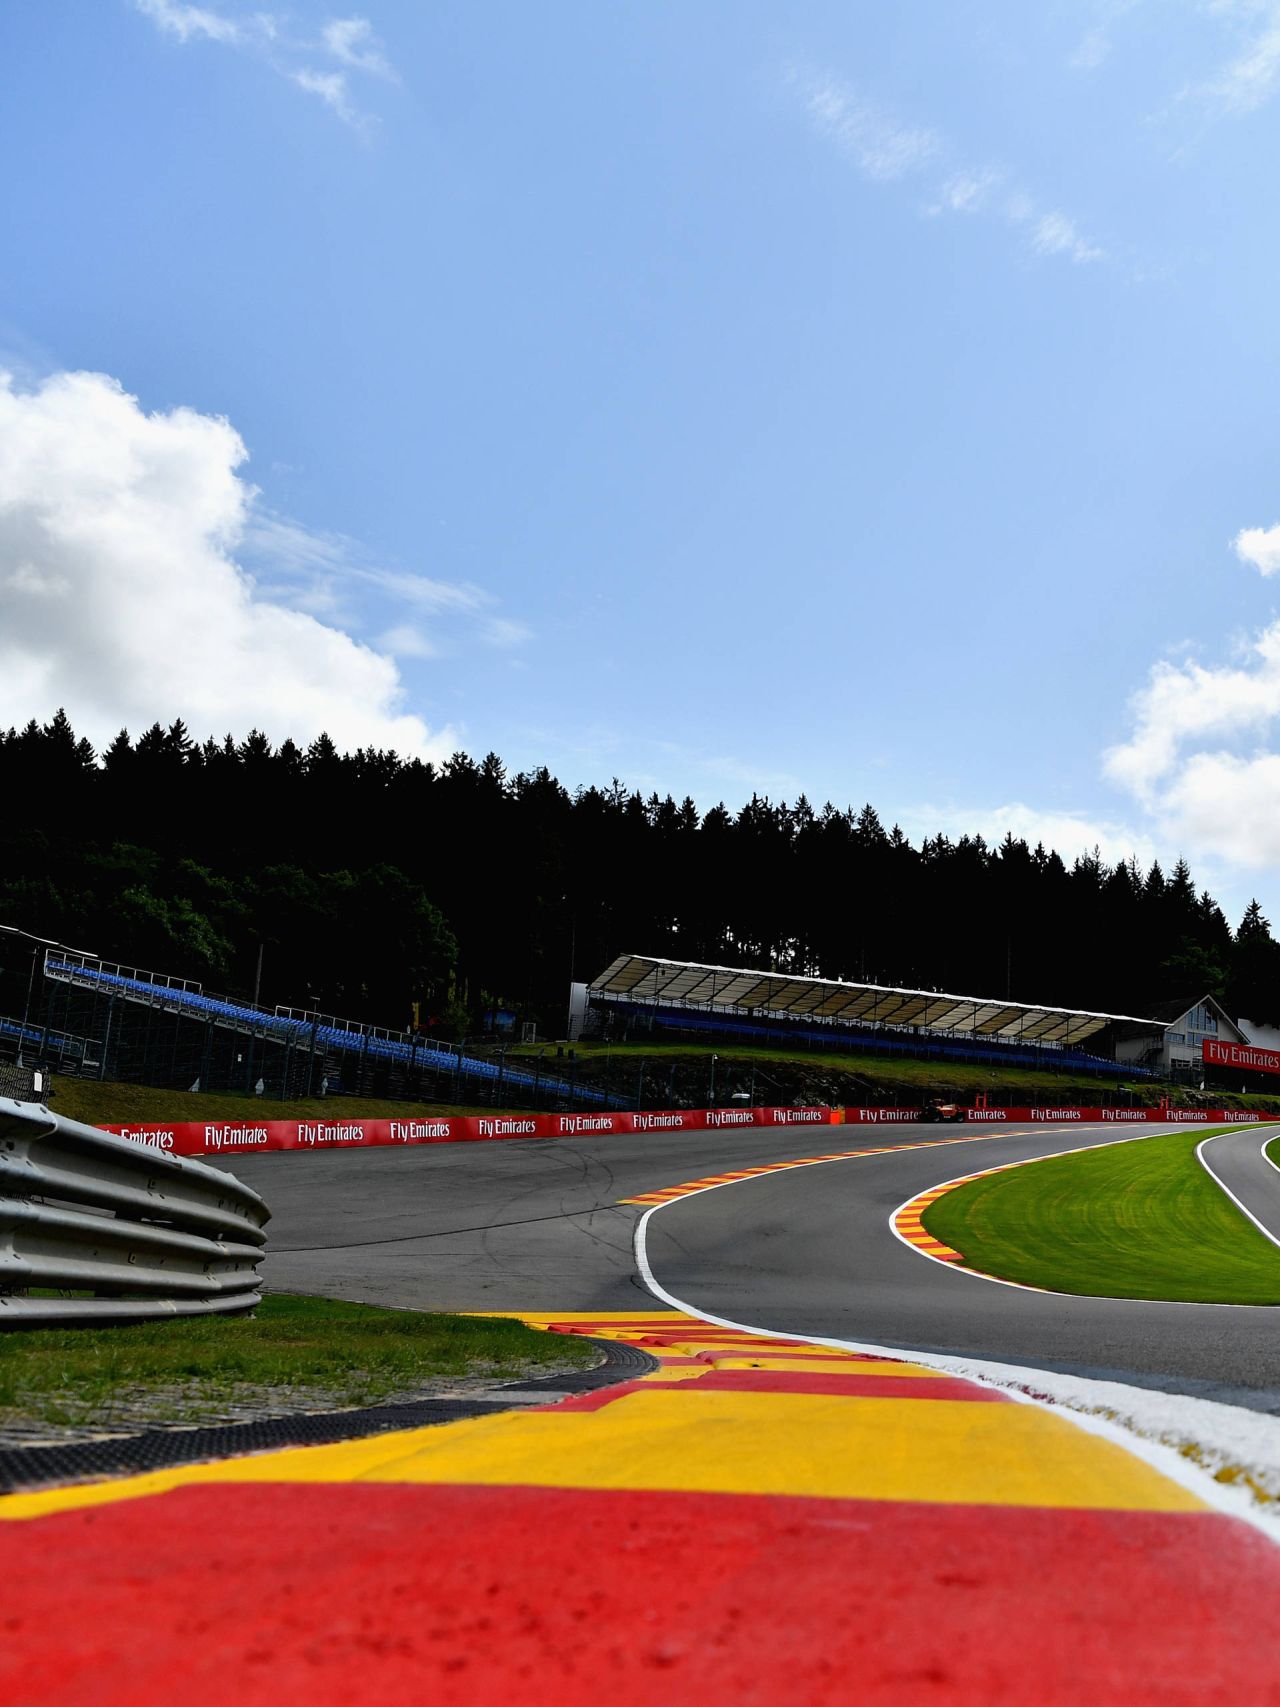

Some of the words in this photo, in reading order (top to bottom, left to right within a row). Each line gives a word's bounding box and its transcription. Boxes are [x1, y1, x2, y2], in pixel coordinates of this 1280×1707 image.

[1210, 1043, 1228, 1063] Fly
[1232, 1046, 1279, 1068] Emirates
[633, 1114, 648, 1130] Fly
[649, 1113, 683, 1127] Emirates
[706, 1112, 721, 1126] Fly
[721, 1110, 754, 1124] Emirates
[773, 1109, 786, 1124] Fly
[787, 1109, 822, 1122] Emirates
[860, 1109, 877, 1122] Fly
[880, 1109, 922, 1120] Emirate
[968, 1109, 1007, 1120] Emirates
[1031, 1109, 1045, 1121] Fly
[1046, 1108, 1081, 1119] Emirates
[1102, 1109, 1114, 1121] Fly
[1116, 1109, 1146, 1119] Emirates
[1166, 1111, 1178, 1121] Fly
[1179, 1110, 1208, 1120] Emirates
[1224, 1111, 1234, 1122] Fly
[1234, 1111, 1260, 1121] Emirates
[390, 1122, 408, 1142] Fly
[410, 1121, 450, 1138] Emirates
[479, 1119, 494, 1137] Fly
[495, 1118, 536, 1134] Emirates
[560, 1117, 575, 1133] Fly
[577, 1116, 612, 1130] Emirates
[205, 1126, 222, 1149] Fly
[224, 1124, 268, 1145] Emirates
[298, 1124, 316, 1145] Fly
[318, 1123, 363, 1141] Emirates
